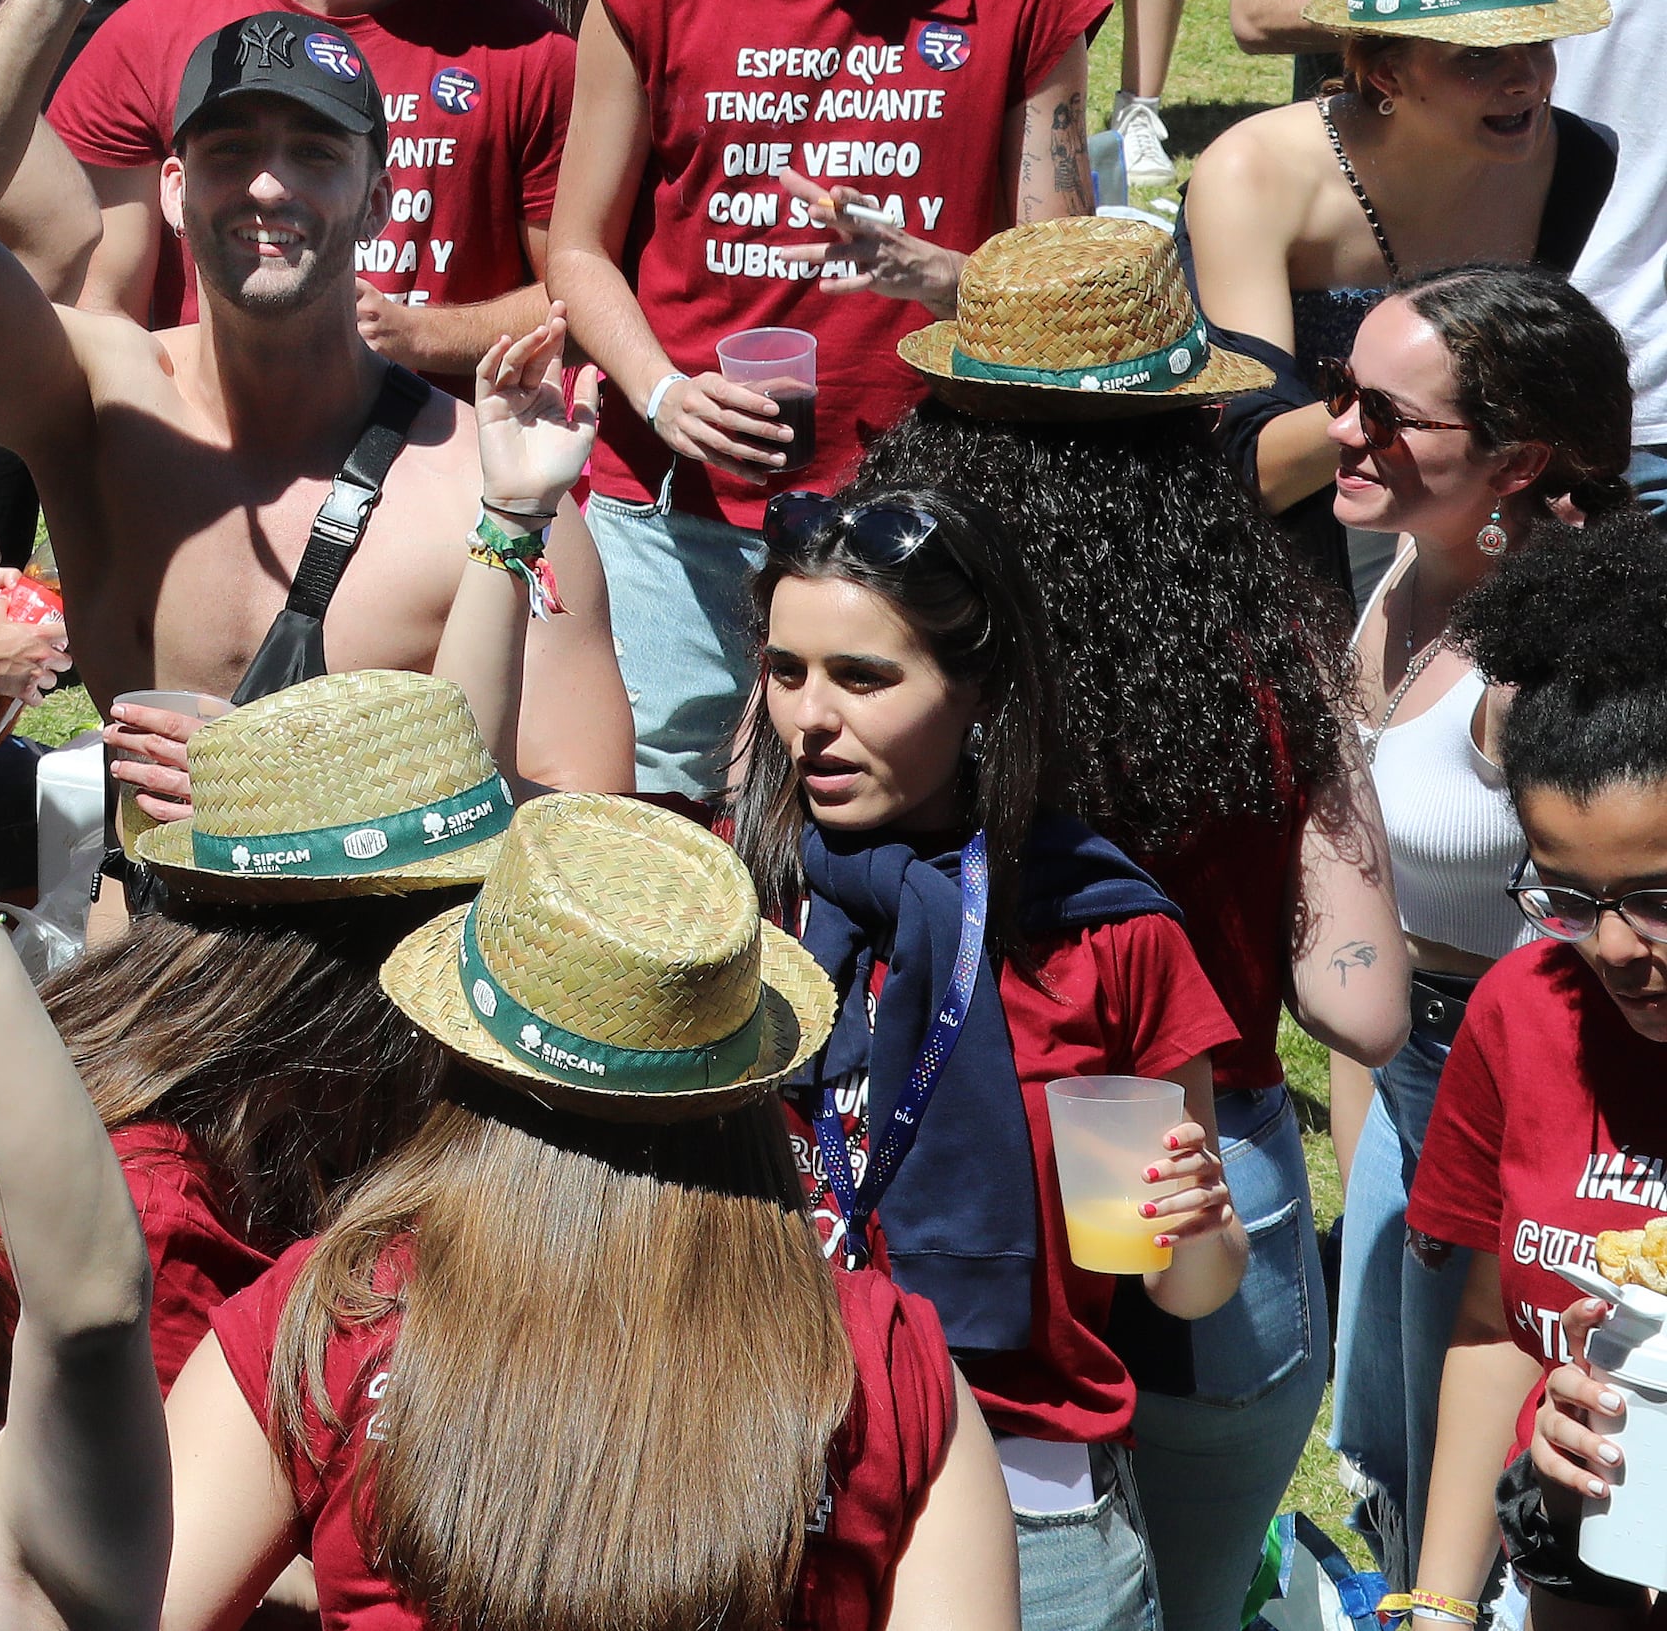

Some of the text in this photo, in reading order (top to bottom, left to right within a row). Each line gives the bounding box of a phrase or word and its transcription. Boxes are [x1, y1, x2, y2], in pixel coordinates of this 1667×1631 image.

[234, 20, 298, 69] NY
[923, 40, 964, 66] RK
[317, 52, 357, 79] RK
[736, 45, 905, 79] ESPERO QUE
[384, 93, 420, 123] UE
[436, 82, 474, 112] RK
[704, 88, 947, 124] TENGAS AGUANTE
[386, 137, 458, 169] ANTE
[722, 140, 921, 179] QUE VENGO
[708, 192, 778, 227] CON
[919, 196, 944, 230] Y
[354, 239, 454, 273] NDA Y
[1102, 370, 1150, 391] SIPCAM
[252, 848, 310, 869] SIPCAM
[447, 803, 494, 831] SIPCAM
[965, 911, 982, 926] blu
[939, 1011, 959, 1028] blu
[542, 1044, 606, 1077] SIPCAM
[894, 1109, 915, 1125] blu
